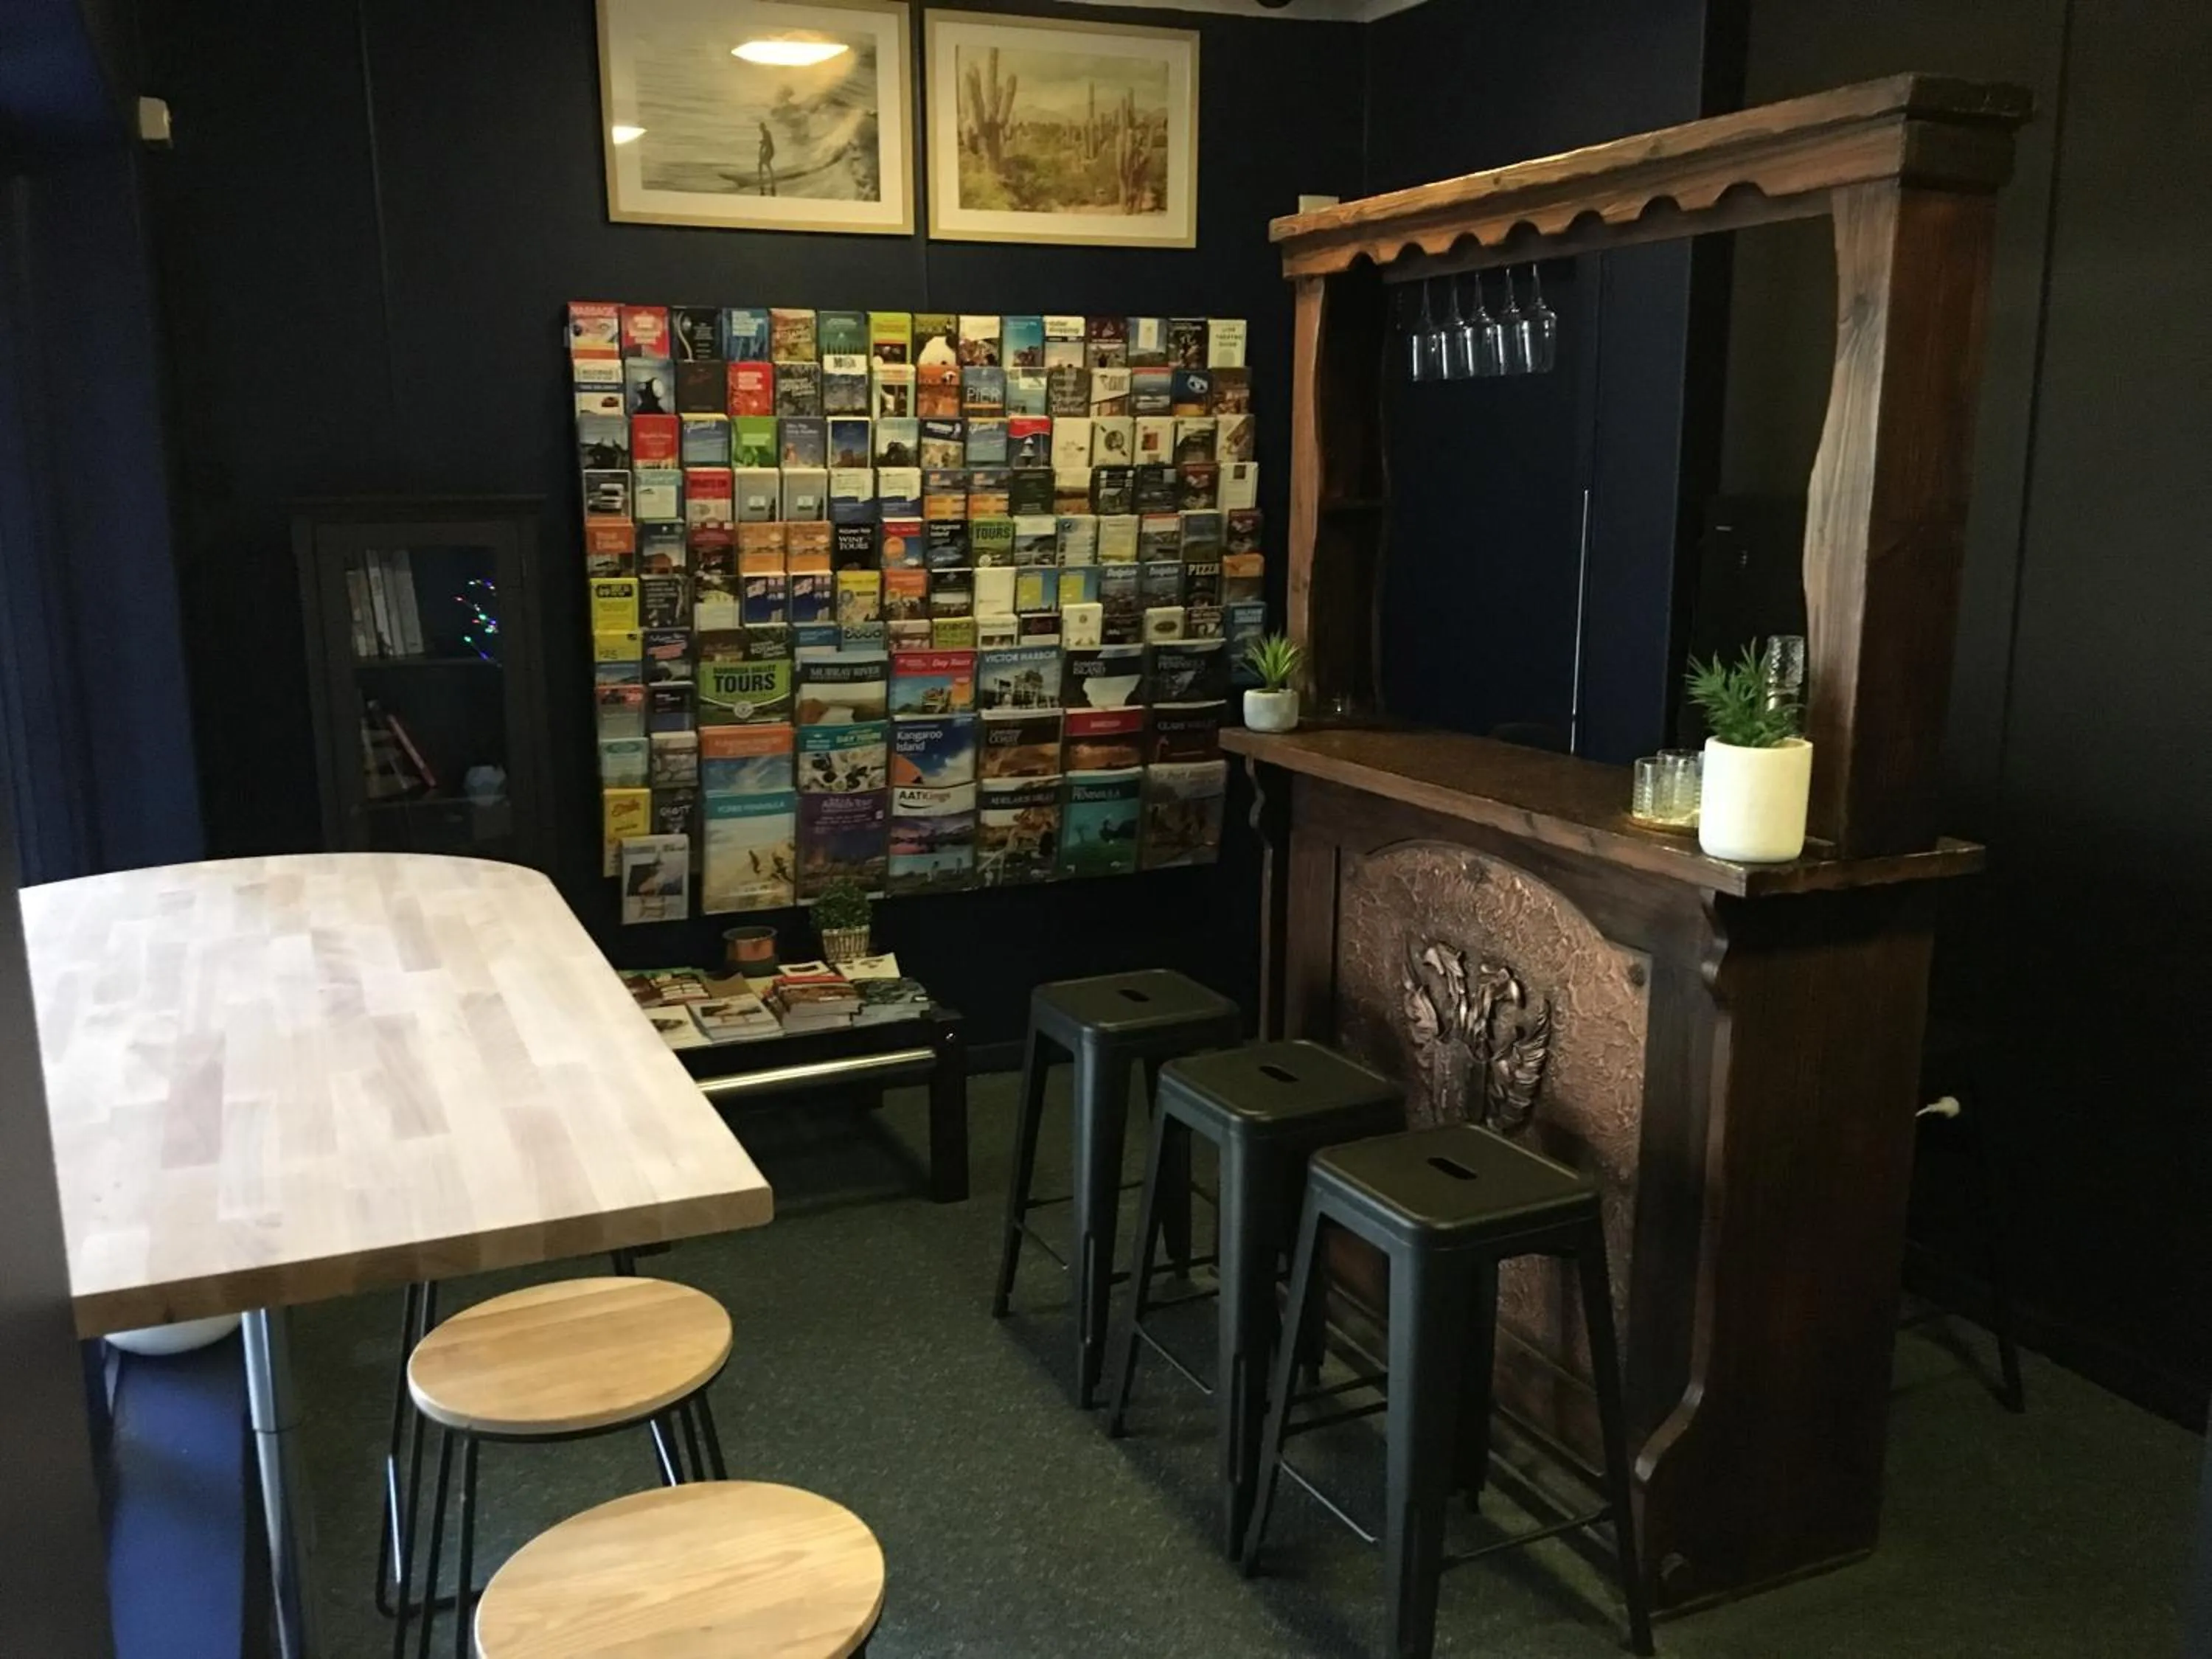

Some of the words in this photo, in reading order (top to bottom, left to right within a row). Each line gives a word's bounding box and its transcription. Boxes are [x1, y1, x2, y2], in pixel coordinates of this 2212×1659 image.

[975, 526, 1011, 540] TOURS
[838, 542, 869, 551] TOURS
[985, 653, 1019, 663] VICTOR
[1020, 650, 1057, 661] HARBOR
[932, 658, 950, 668] Day
[810, 667, 851, 678] MURRAY
[852, 666, 880, 676] RIVER
[714, 672, 776, 693] TOURS
[897, 730, 943, 742] Kangaroo
[896, 741, 926, 752] Island
